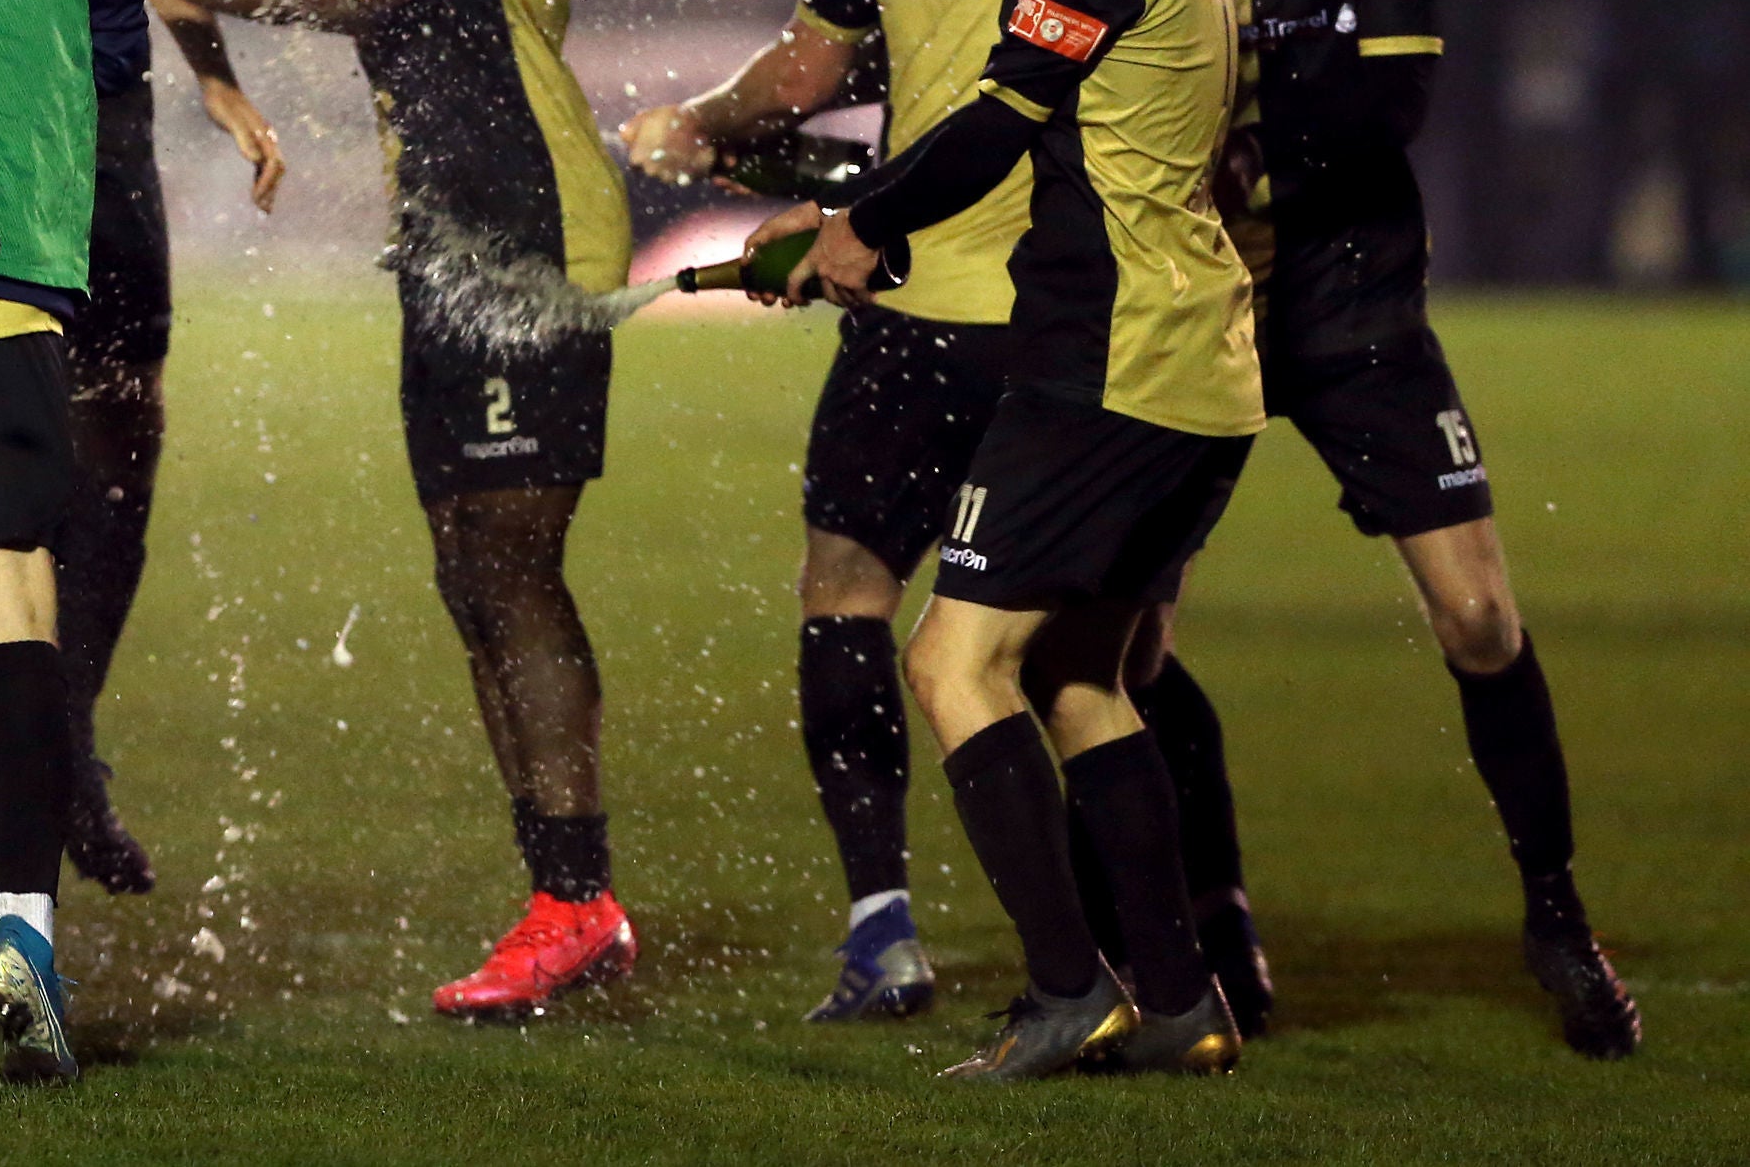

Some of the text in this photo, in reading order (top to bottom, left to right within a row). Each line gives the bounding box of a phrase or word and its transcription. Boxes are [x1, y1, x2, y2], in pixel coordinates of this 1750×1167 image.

[483, 376, 514, 435] 2
[1436, 408, 1477, 466] 15
[951, 483, 989, 544] 11
